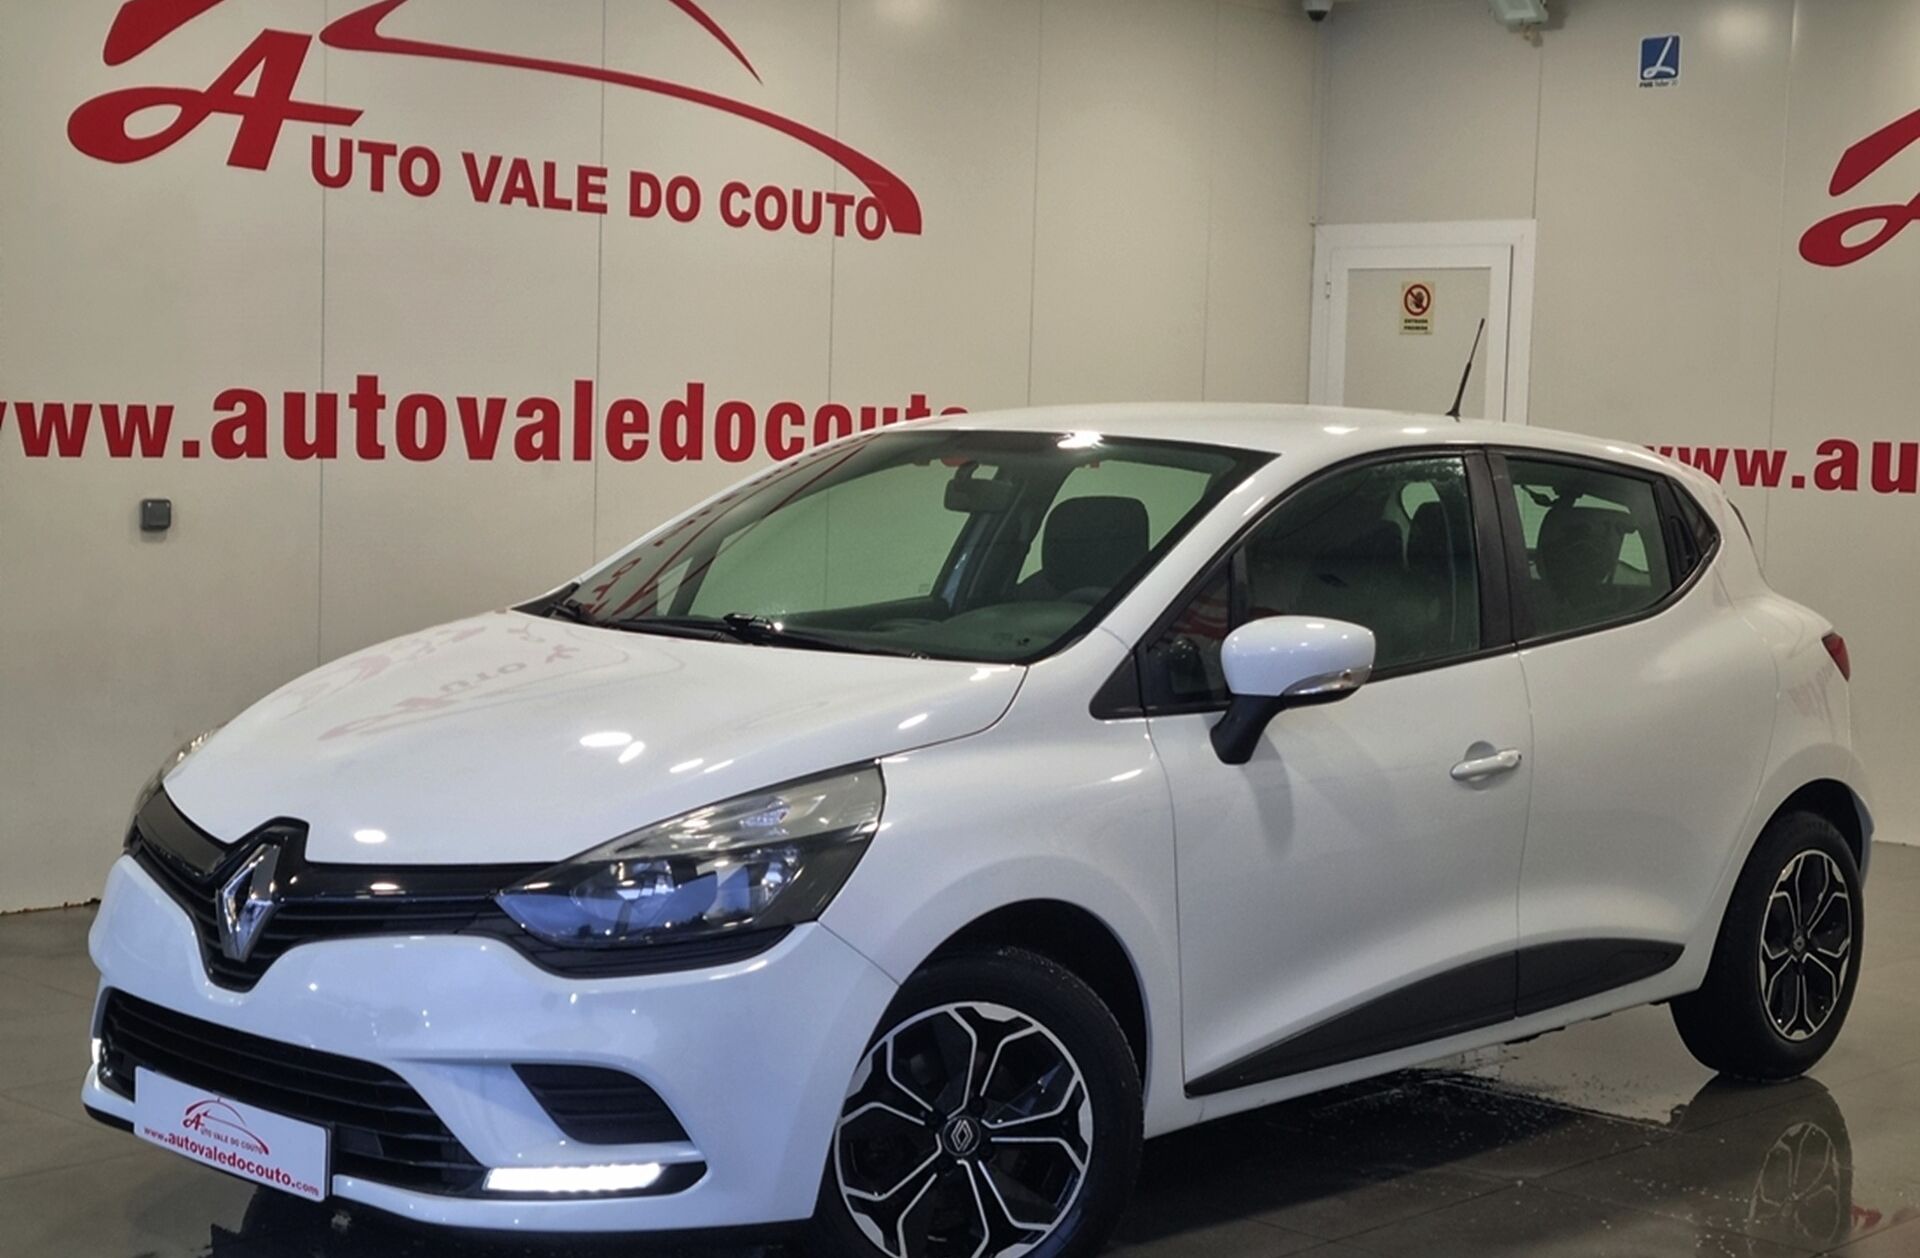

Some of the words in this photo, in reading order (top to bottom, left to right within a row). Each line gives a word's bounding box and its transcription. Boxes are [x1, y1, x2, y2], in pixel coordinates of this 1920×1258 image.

[463, 152, 608, 215] VALE
[629, 170, 703, 224] DO
[720, 180, 887, 241] COUTO
[0, 374, 968, 463] ww.autovaledoco
[1643, 438, 1920, 493] ww.au
[144, 1126, 319, 1197] www.autovaledocouto.com
